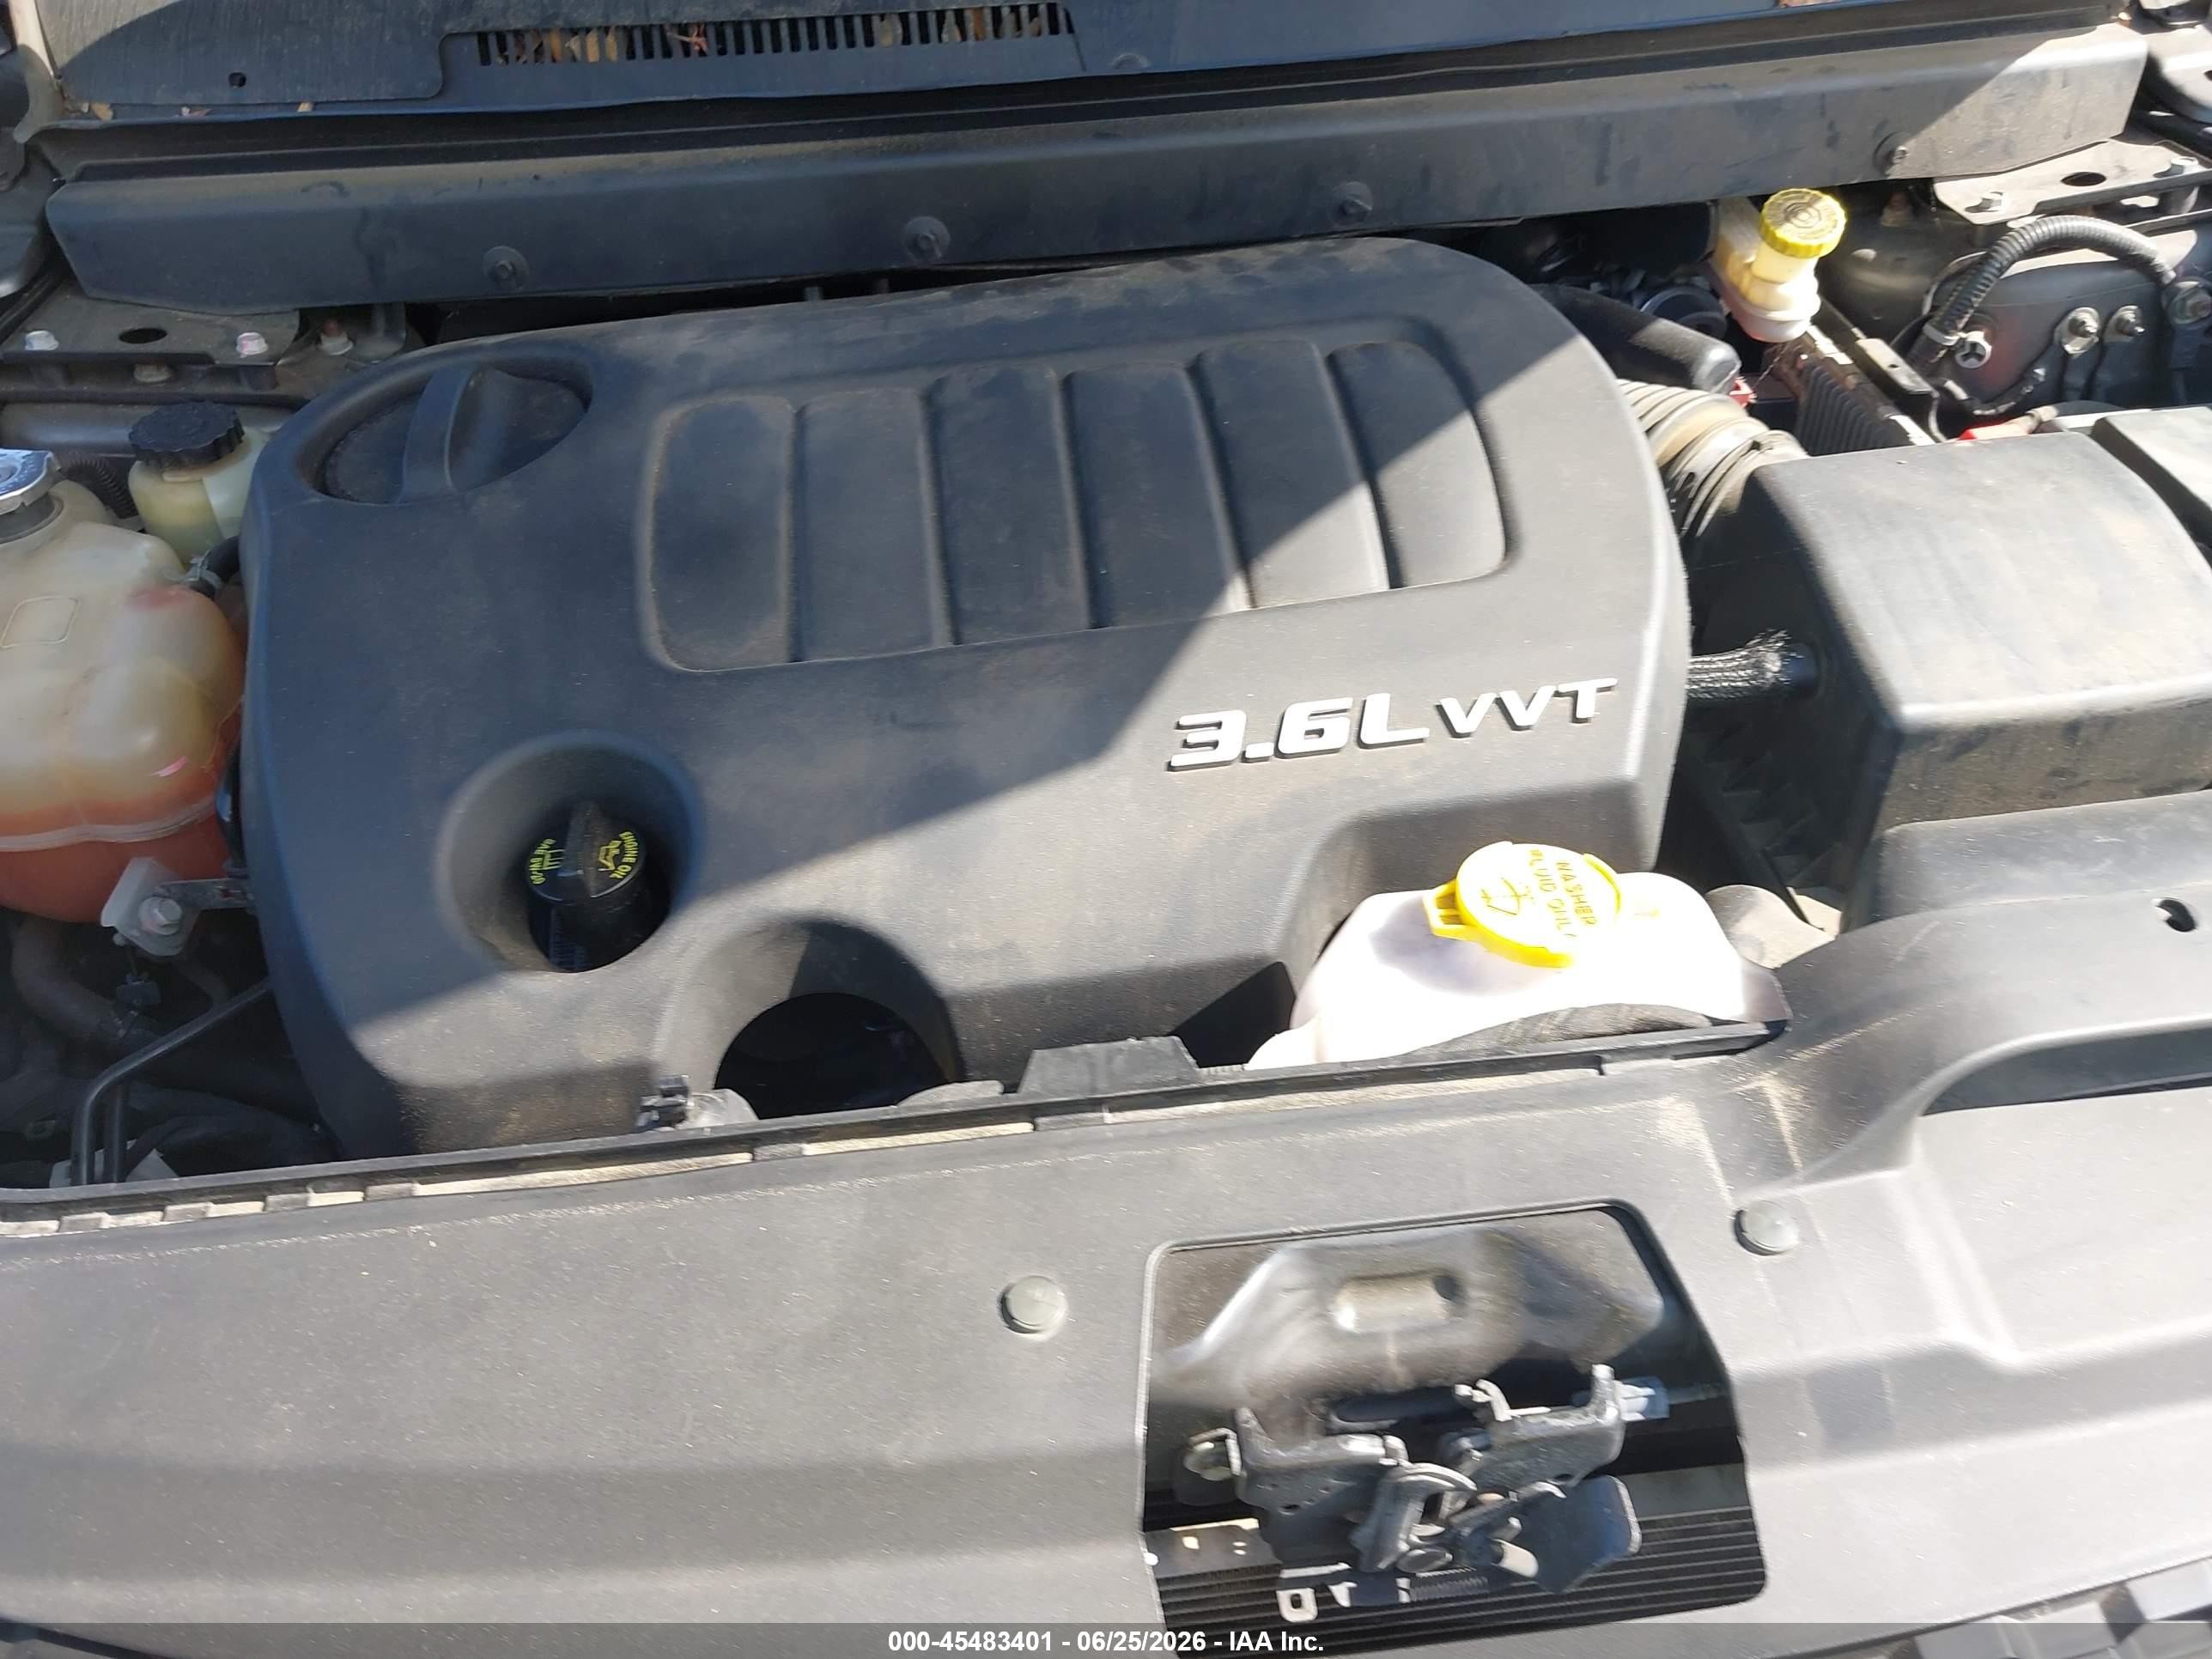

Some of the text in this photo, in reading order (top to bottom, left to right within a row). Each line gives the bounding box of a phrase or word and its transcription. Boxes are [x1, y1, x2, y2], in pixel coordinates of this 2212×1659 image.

[1168, 678, 1618, 771] 3.6L VVT
[608, 831, 639, 879] ENGINE OIL
[1528, 849, 1557, 893] FLUID
[1555, 861, 1597, 926] WASHER
